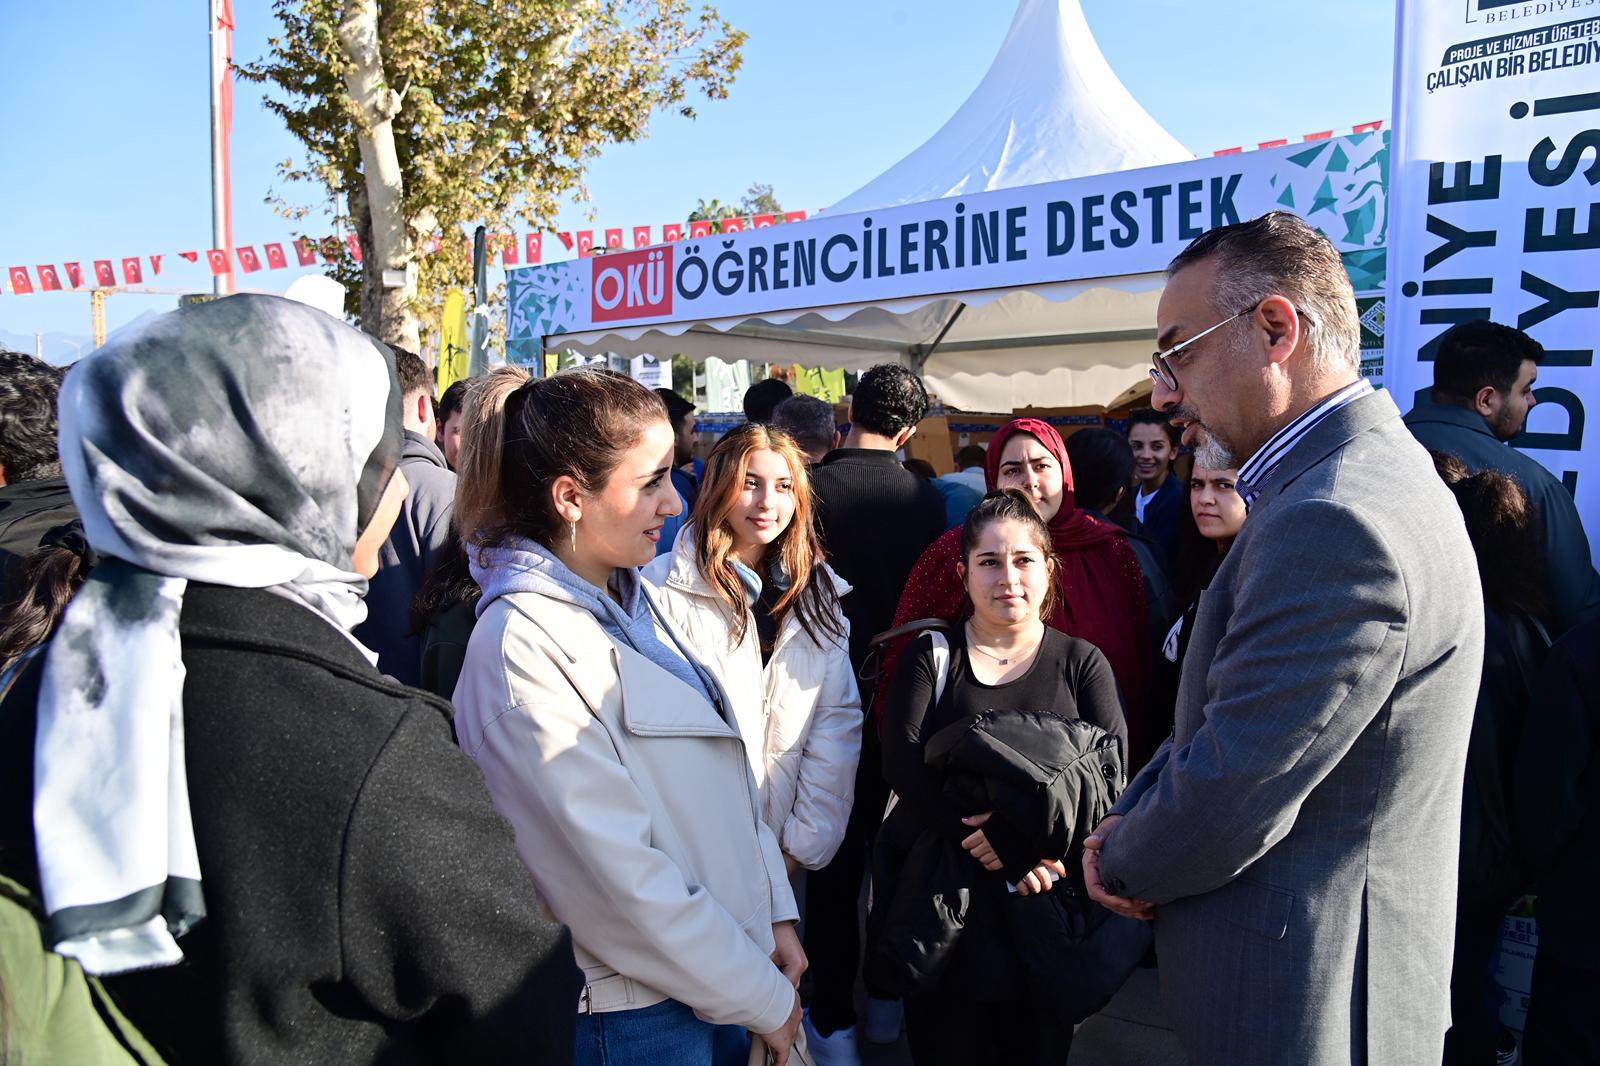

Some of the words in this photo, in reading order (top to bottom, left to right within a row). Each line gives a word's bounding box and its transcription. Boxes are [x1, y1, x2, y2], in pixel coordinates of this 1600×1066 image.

[1486, 0, 1600, 24] BELEDİYES
[1427, 60, 1493, 94] ÇALIŞAN
[1496, 52, 1525, 78] BİR
[1528, 37, 1600, 73] BELEDİY
[1449, 44, 1484, 63] PROJE
[1486, 41, 1501, 55] VE
[1503, 30, 1549, 52] HİZMET
[1551, 20, 1600, 42] ÜRETEB
[595, 251, 665, 310] OKÜ
[676, 202, 1027, 301] ÖĞRENCİLERİNE
[1047, 173, 1243, 257] DESTEK
[1402, 154, 1502, 408] NİYE
